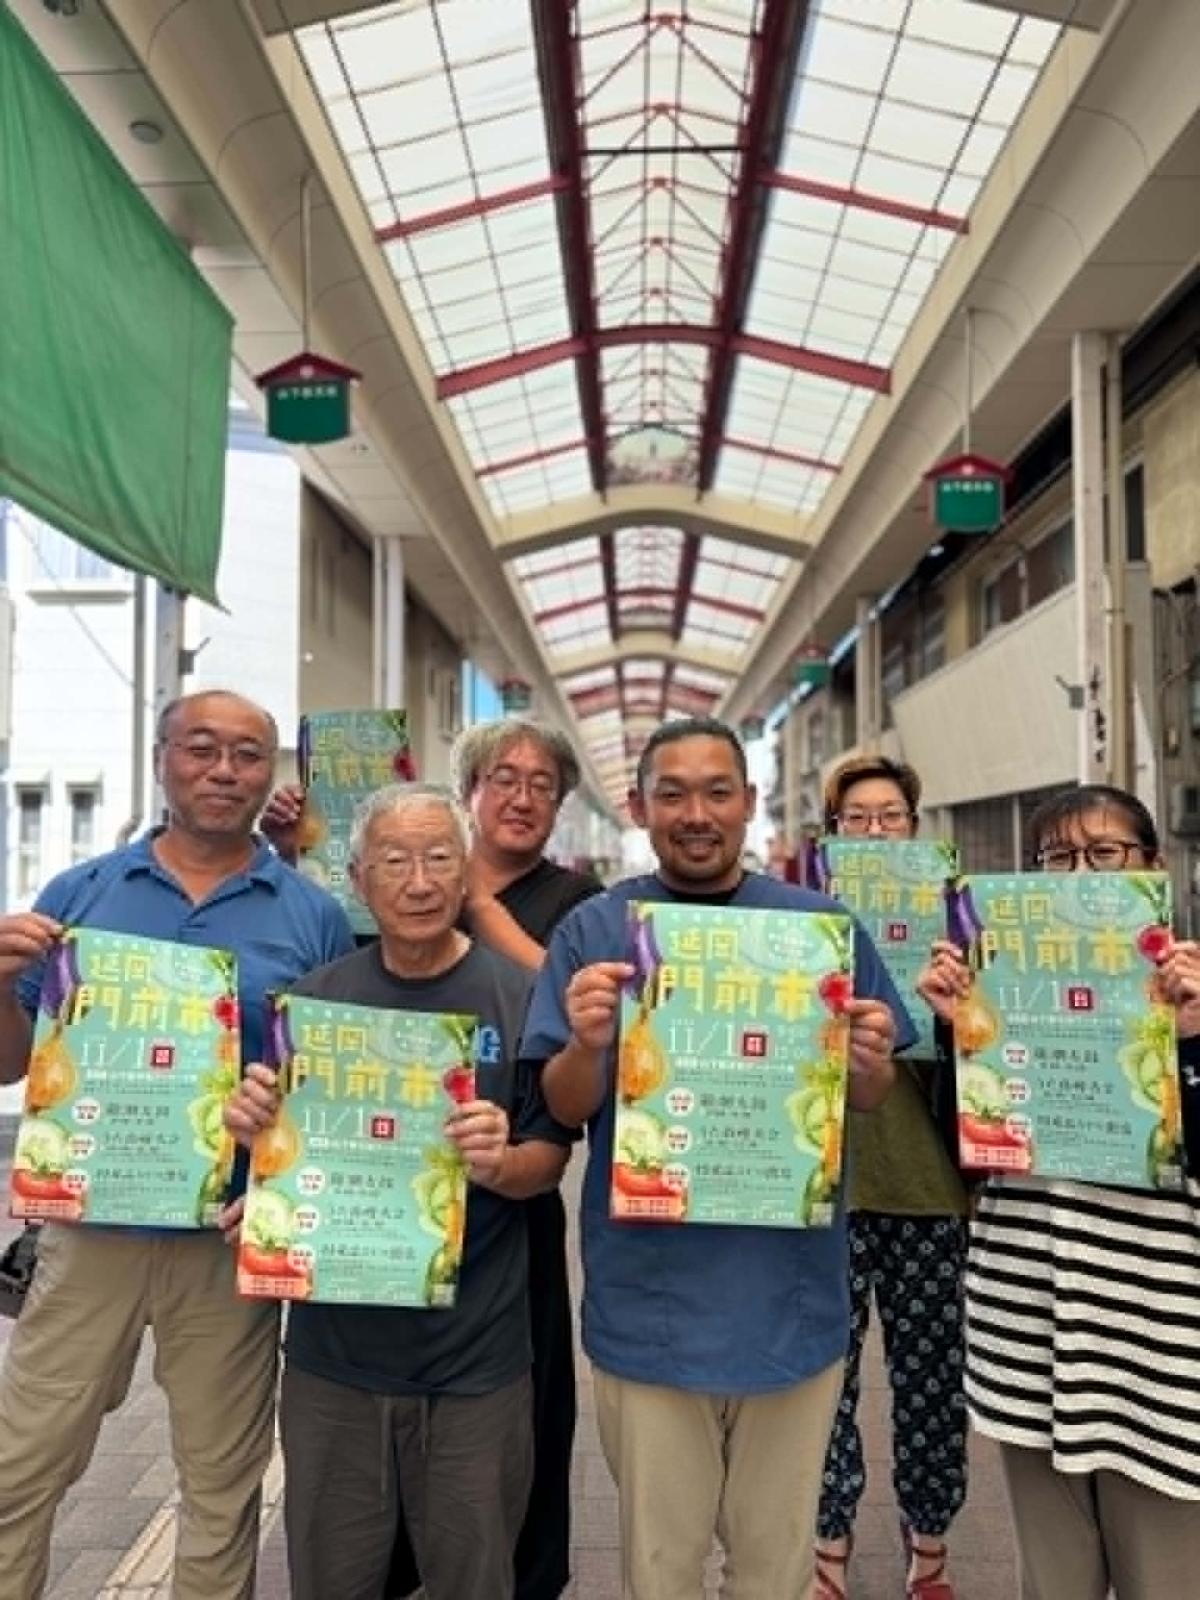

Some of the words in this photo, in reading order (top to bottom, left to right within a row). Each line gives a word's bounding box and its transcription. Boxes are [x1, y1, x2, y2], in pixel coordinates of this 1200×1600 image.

[981, 928, 1136, 975] 門前市
[71, 985, 213, 1035] 門前市
[657, 963, 814, 1021] 門前市
[292, 1056, 440, 1108] 門前市
